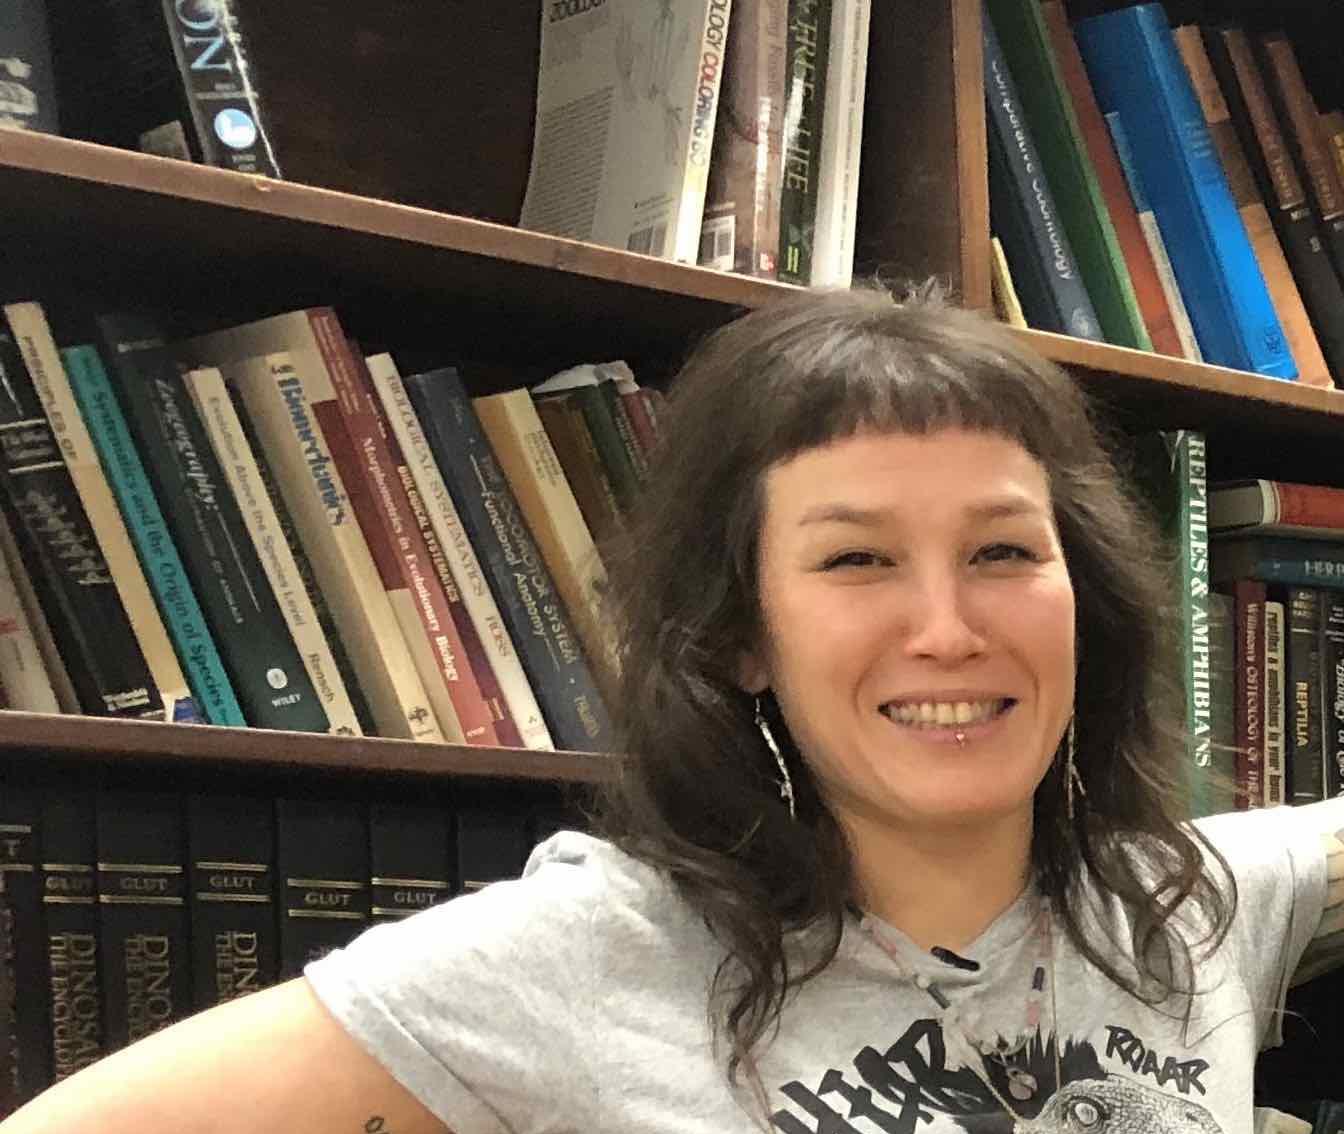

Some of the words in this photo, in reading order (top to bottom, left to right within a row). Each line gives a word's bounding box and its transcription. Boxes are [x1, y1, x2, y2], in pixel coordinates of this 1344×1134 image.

[693, 51, 719, 140] COLORING
[1187, 435, 1209, 573] REPTILES
[94, 391, 138, 495] Systematics
[159, 562, 190, 618] Origin
[190, 643, 224, 706] Species
[422, 530, 461, 604] SYSTEMATICS
[480, 491, 521, 566] Functional
[511, 571, 547, 637] Anatomy
[404, 552, 441, 633] Evolutionary
[435, 635, 459, 682] Biology
[1190, 575, 1209, 598] &
[543, 603, 578, 665] SYSTEM
[1190, 603, 1212, 769] AMPHIBIANS
[1295, 681, 1309, 747] REPTILIA
[45, 875, 94, 891] GLUT
[119, 876, 169, 892] GLUT
[209, 874, 255, 889] GLUT
[304, 891, 351, 907] GLUT
[393, 890, 437, 906] GLUT
[1104, 1024, 1210, 1097] ROAAR
